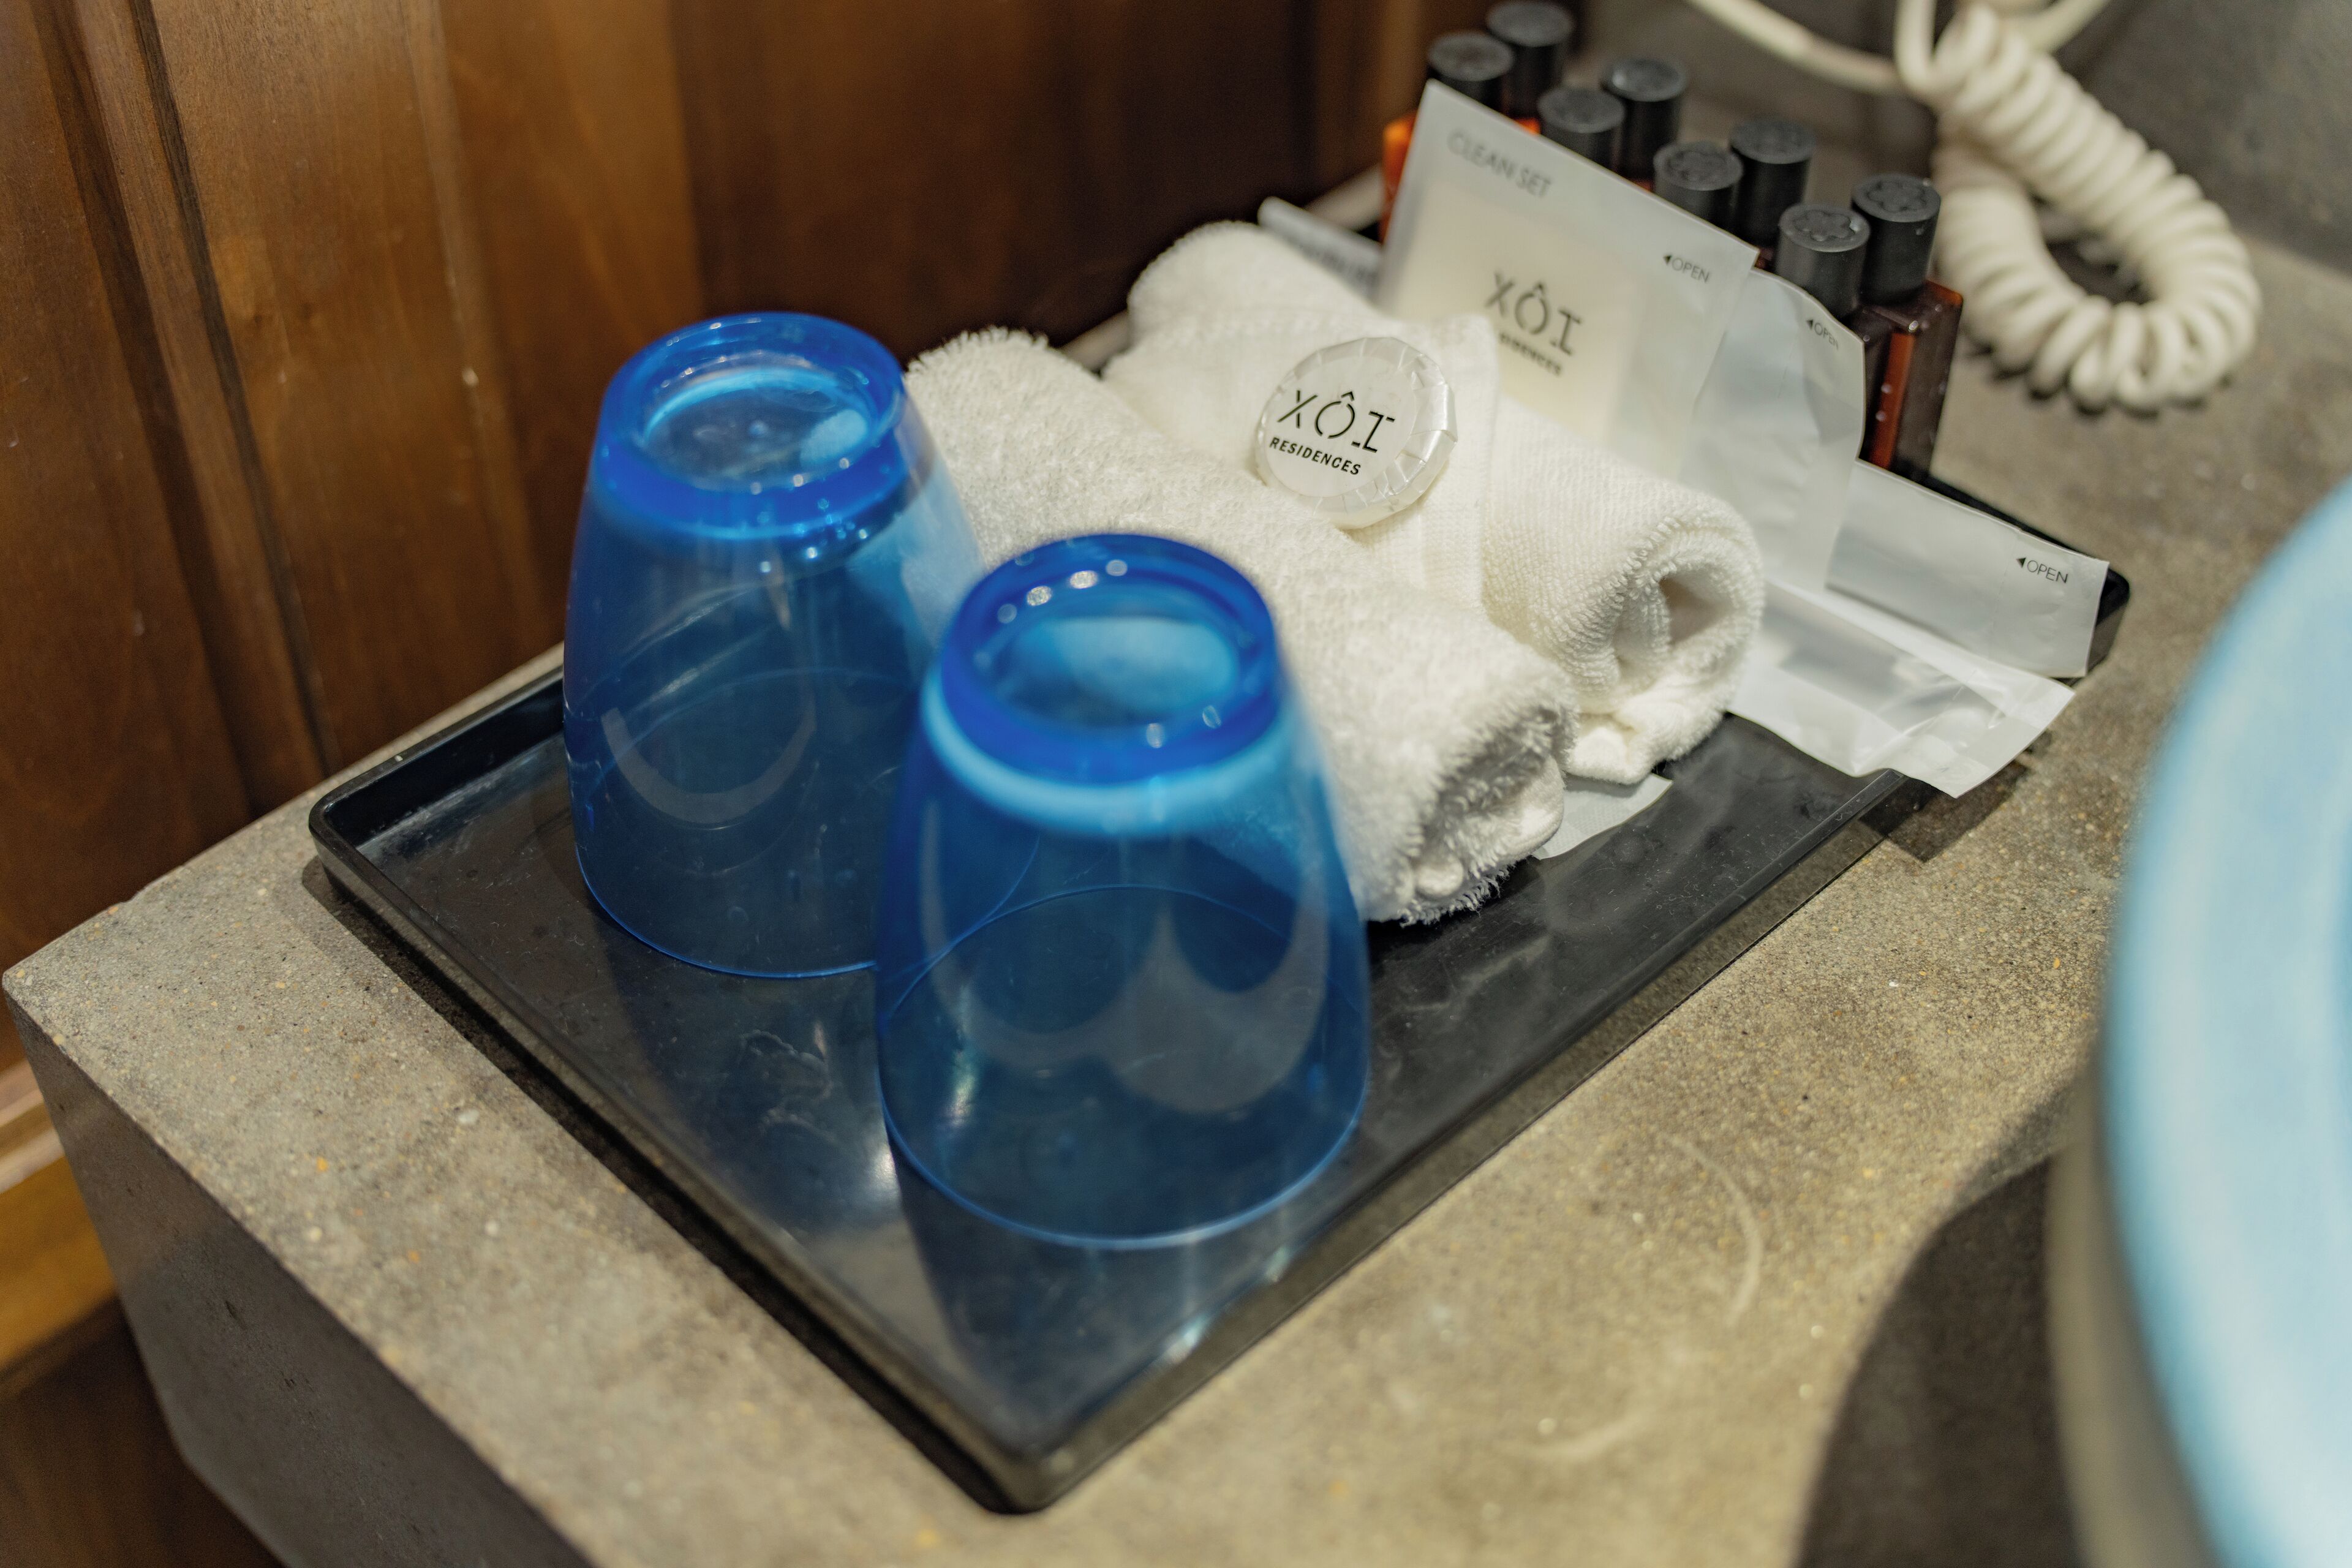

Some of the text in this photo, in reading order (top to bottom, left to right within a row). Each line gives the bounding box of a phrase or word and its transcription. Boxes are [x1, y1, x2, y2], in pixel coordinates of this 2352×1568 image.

[1447, 129, 1551, 197] CLEAN SET
[1672, 257, 1709, 282] OPEN
[1485, 270, 1581, 356] XÔI
[1814, 322, 1838, 350] OPEN
[1276, 390, 1395, 453] XÔI
[1269, 437, 1362, 475] RESIDENCES
[2027, 560, 2068, 583] OPEN
